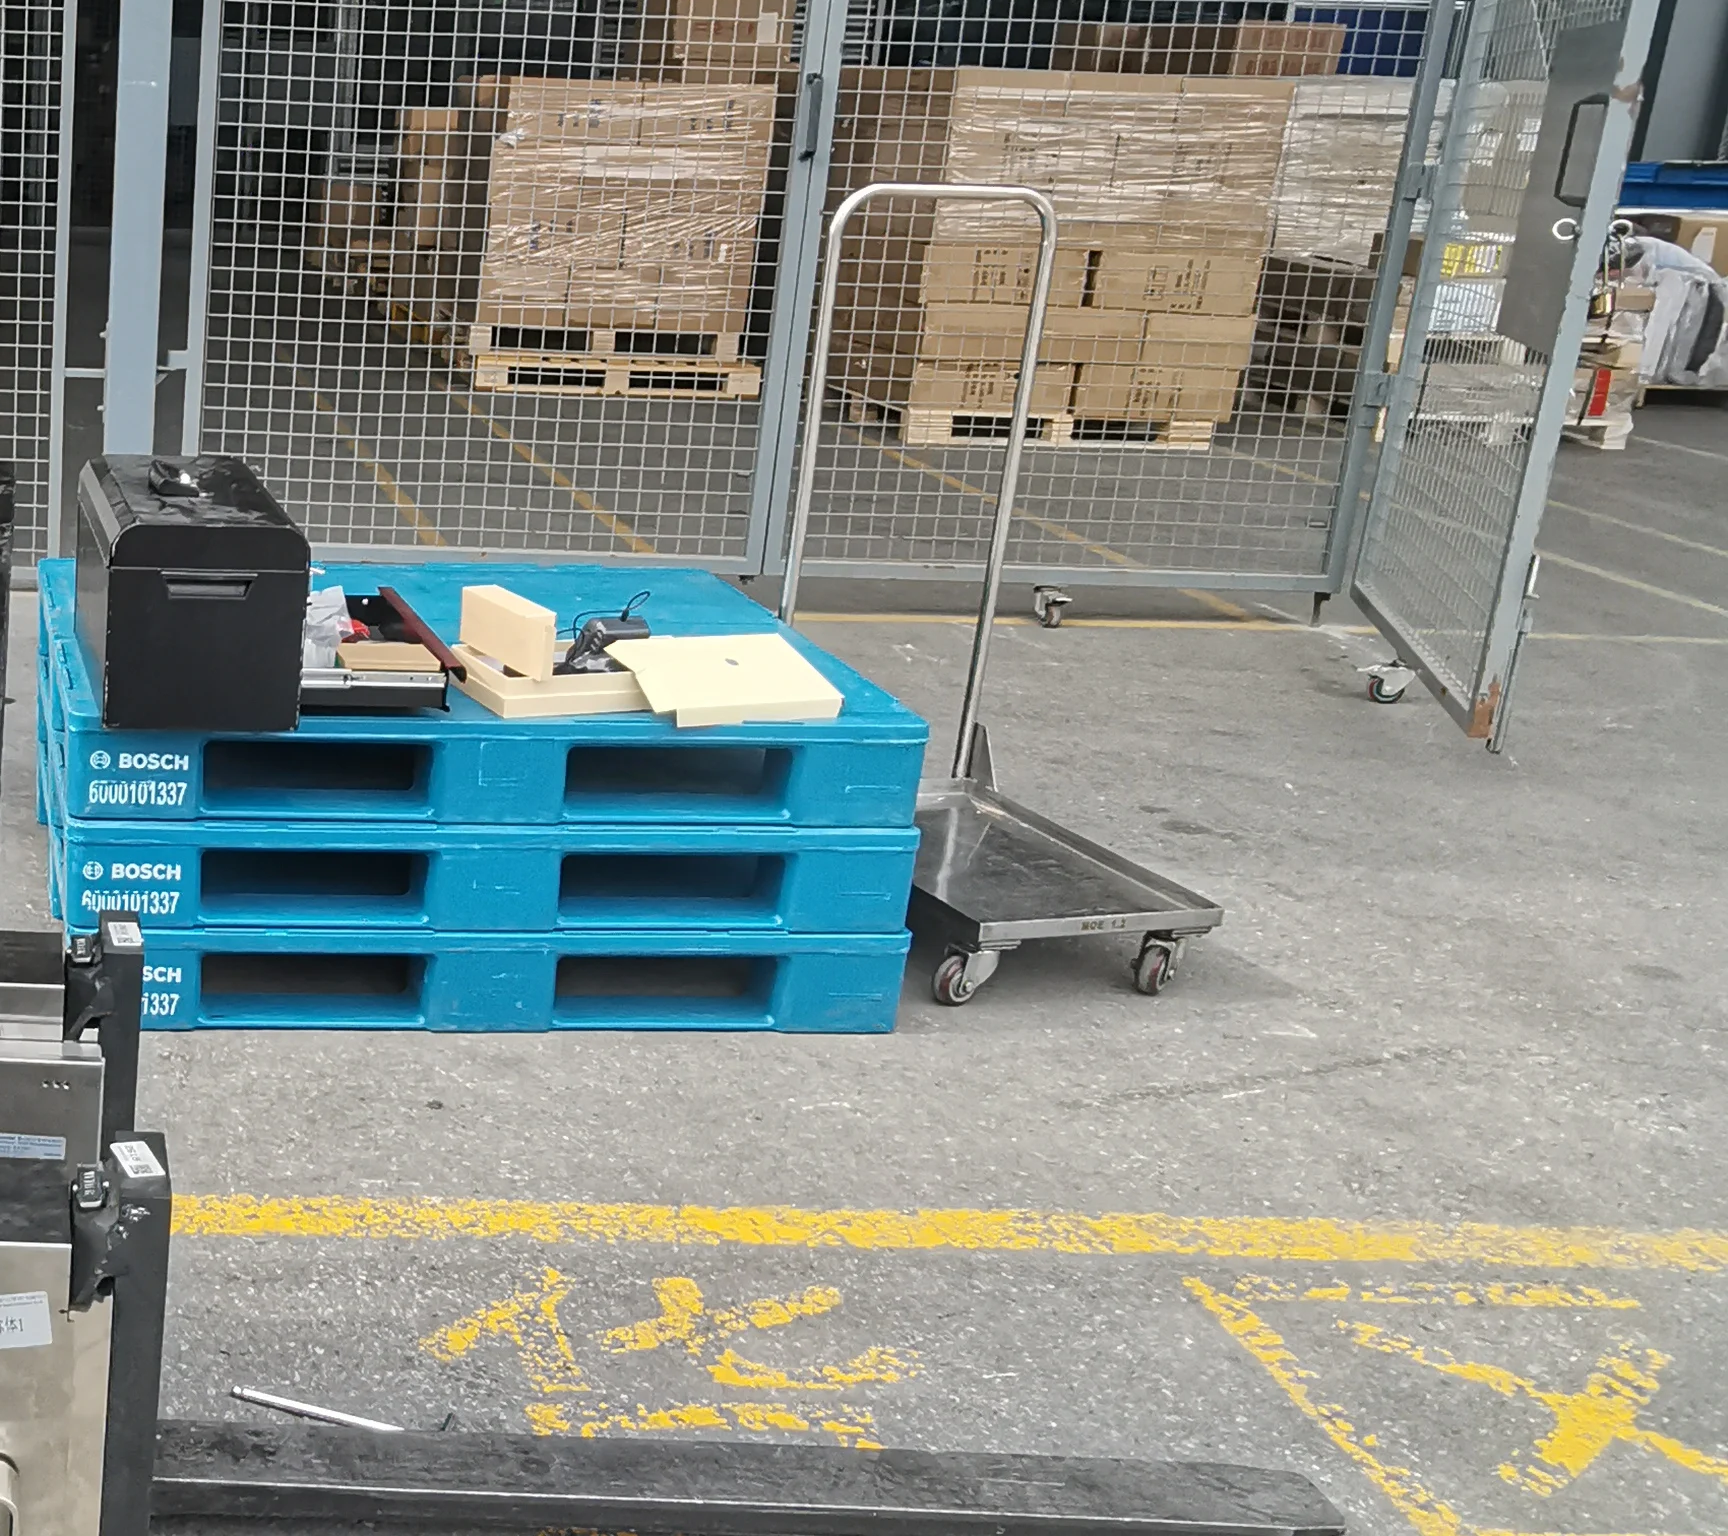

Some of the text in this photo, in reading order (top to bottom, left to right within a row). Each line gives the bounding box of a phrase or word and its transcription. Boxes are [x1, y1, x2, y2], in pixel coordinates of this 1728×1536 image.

[119, 753, 189, 771] BOSCH
[89, 780, 187, 806] 6000101337
[111, 863, 182, 881] BOSCH
[142, 965, 182, 983] SCH
